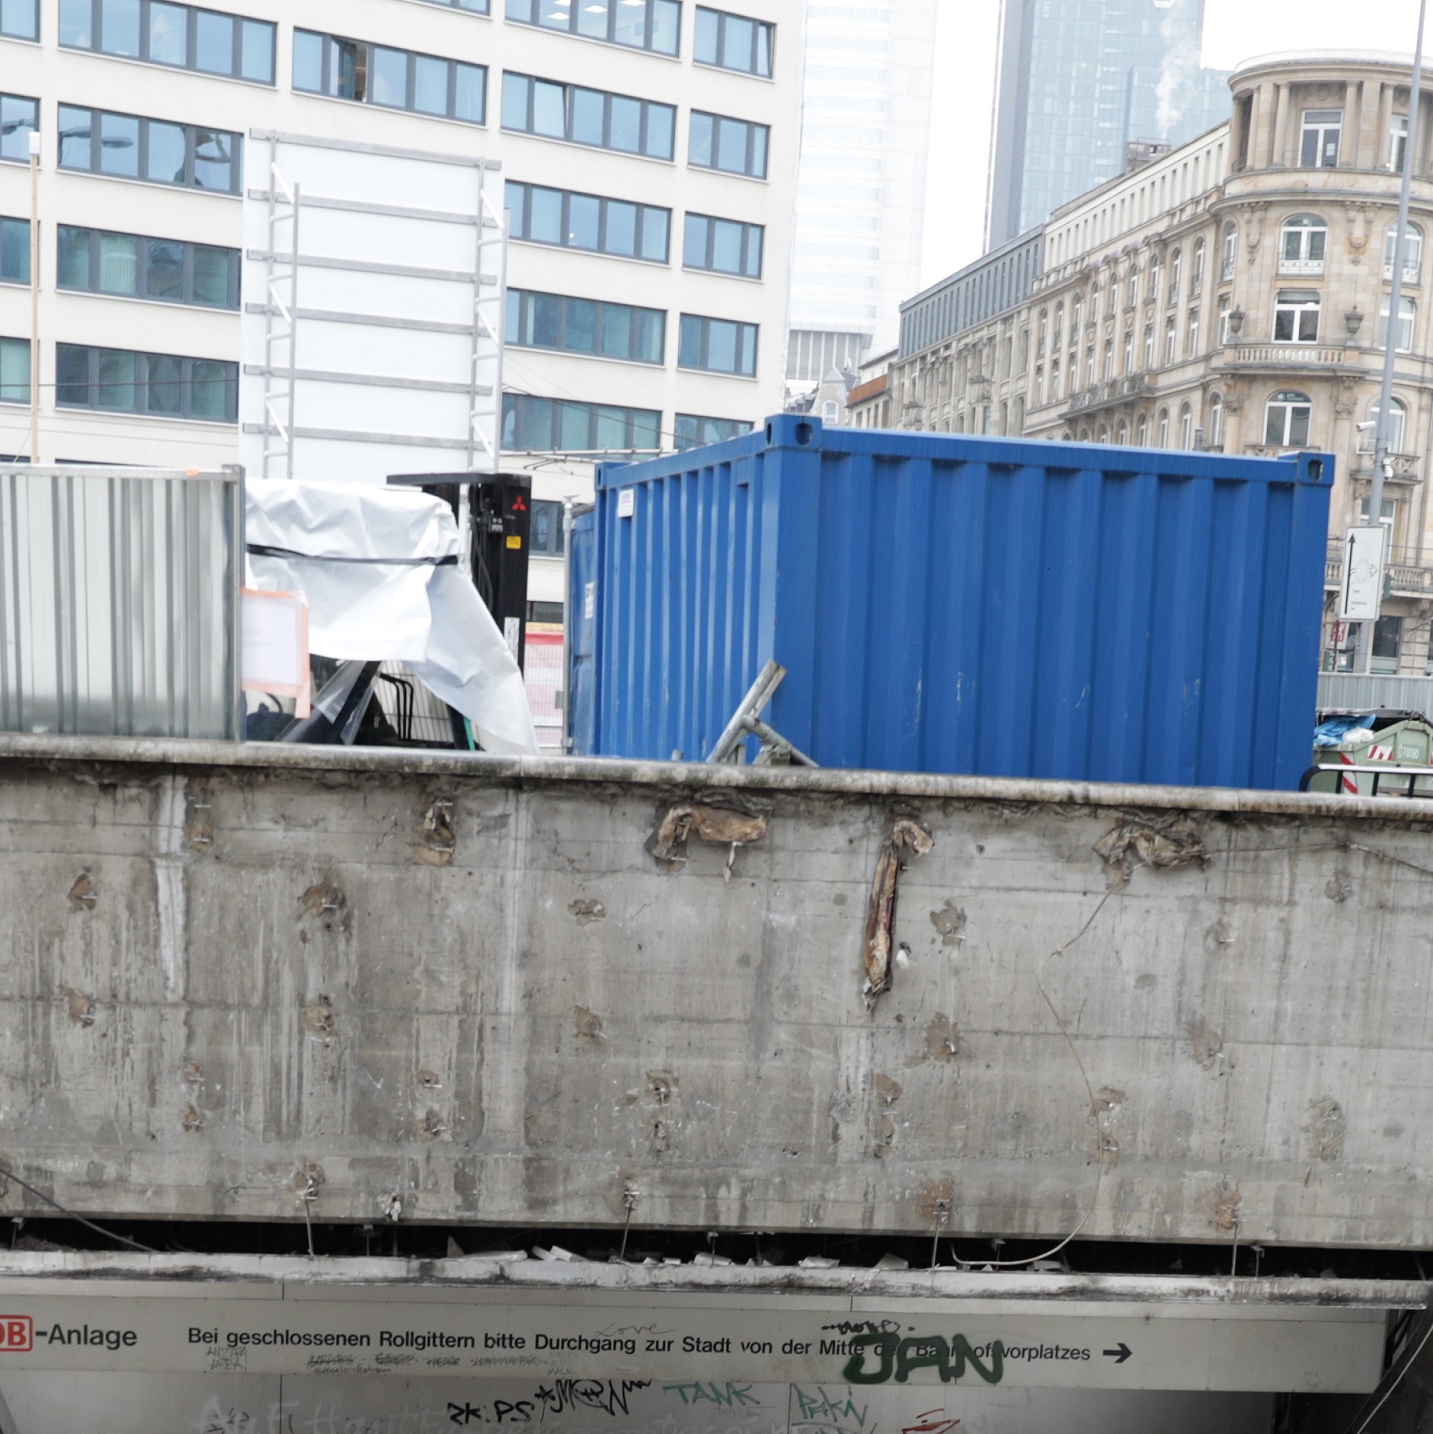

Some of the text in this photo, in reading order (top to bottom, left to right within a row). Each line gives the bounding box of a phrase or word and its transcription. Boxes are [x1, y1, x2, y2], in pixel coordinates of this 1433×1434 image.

[188, 1327, 219, 1345] Bei
[226, 1327, 371, 1352] geschlossenen
[379, 1331, 475, 1351] Rollgittern
[484, 1332, 526, 1350] bitte
[534, 1334, 636, 1355] Durchgang
[645, 1340, 675, 1353] zur
[681, 1336, 732, 1354] Stadt
[740, 1341, 773, 1354] von
[781, 1339, 812, 1355] der
[819, 1340, 865, 1357] Mitte
